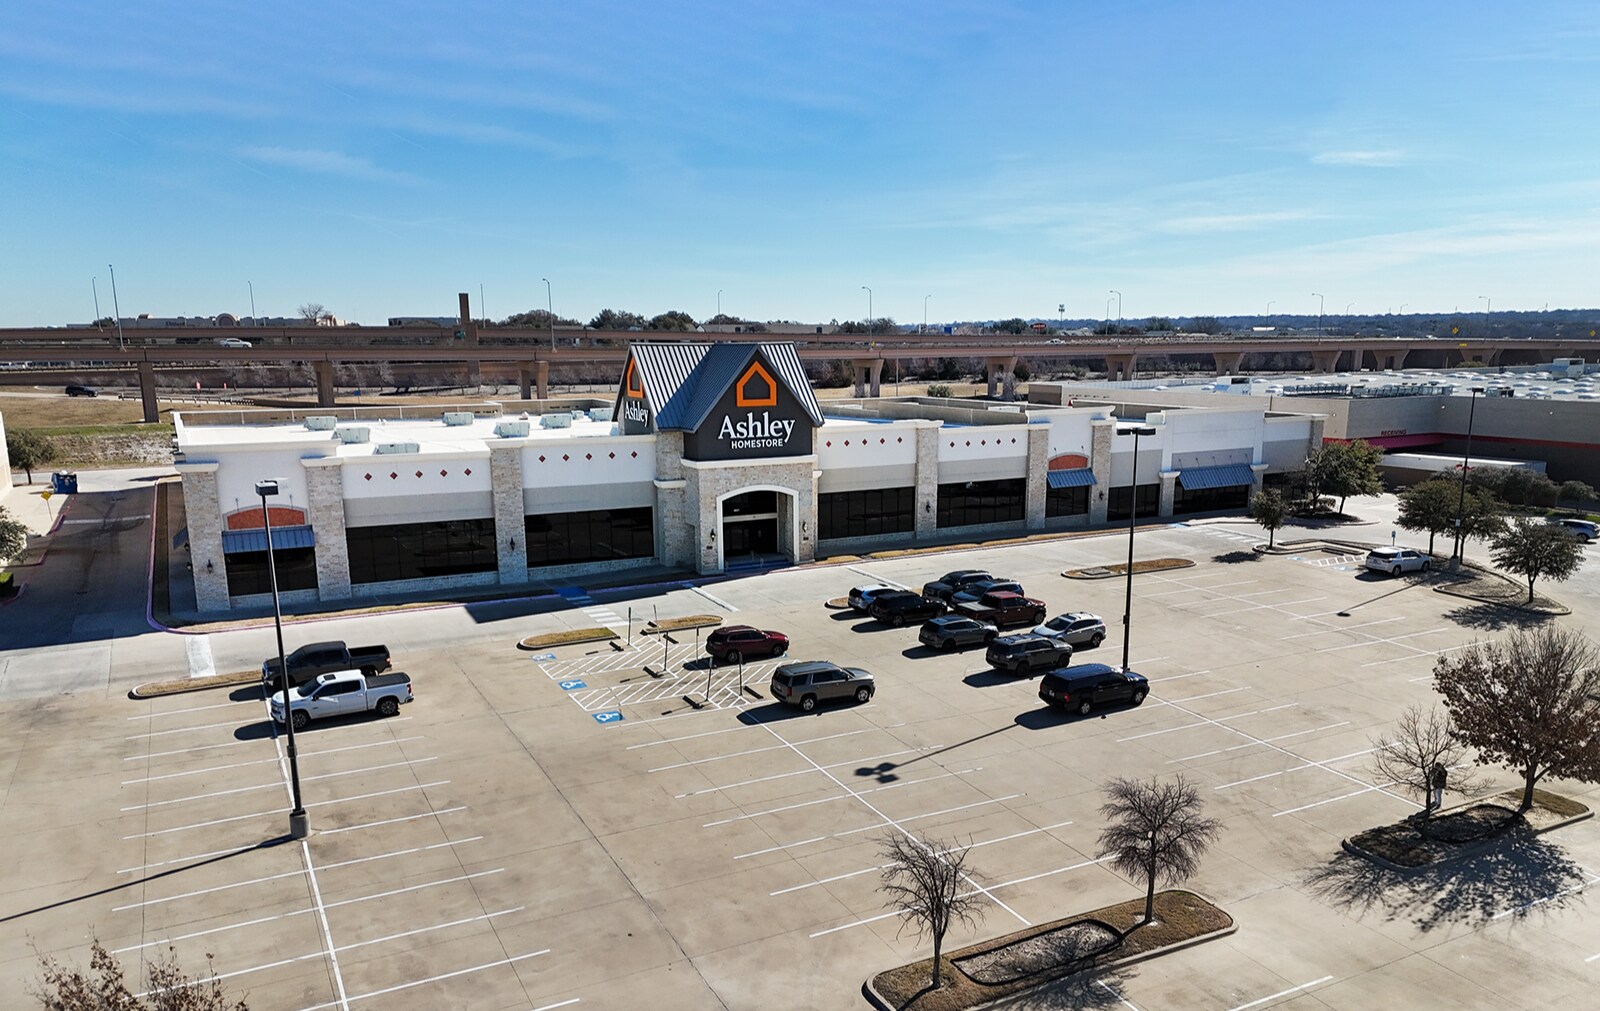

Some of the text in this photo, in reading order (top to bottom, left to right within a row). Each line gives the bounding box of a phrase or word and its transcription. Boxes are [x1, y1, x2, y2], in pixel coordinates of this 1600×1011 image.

[625, 400, 649, 428] Ashley
[718, 411, 796, 443] Ashley
[731, 438, 784, 450] HOMESTORE
